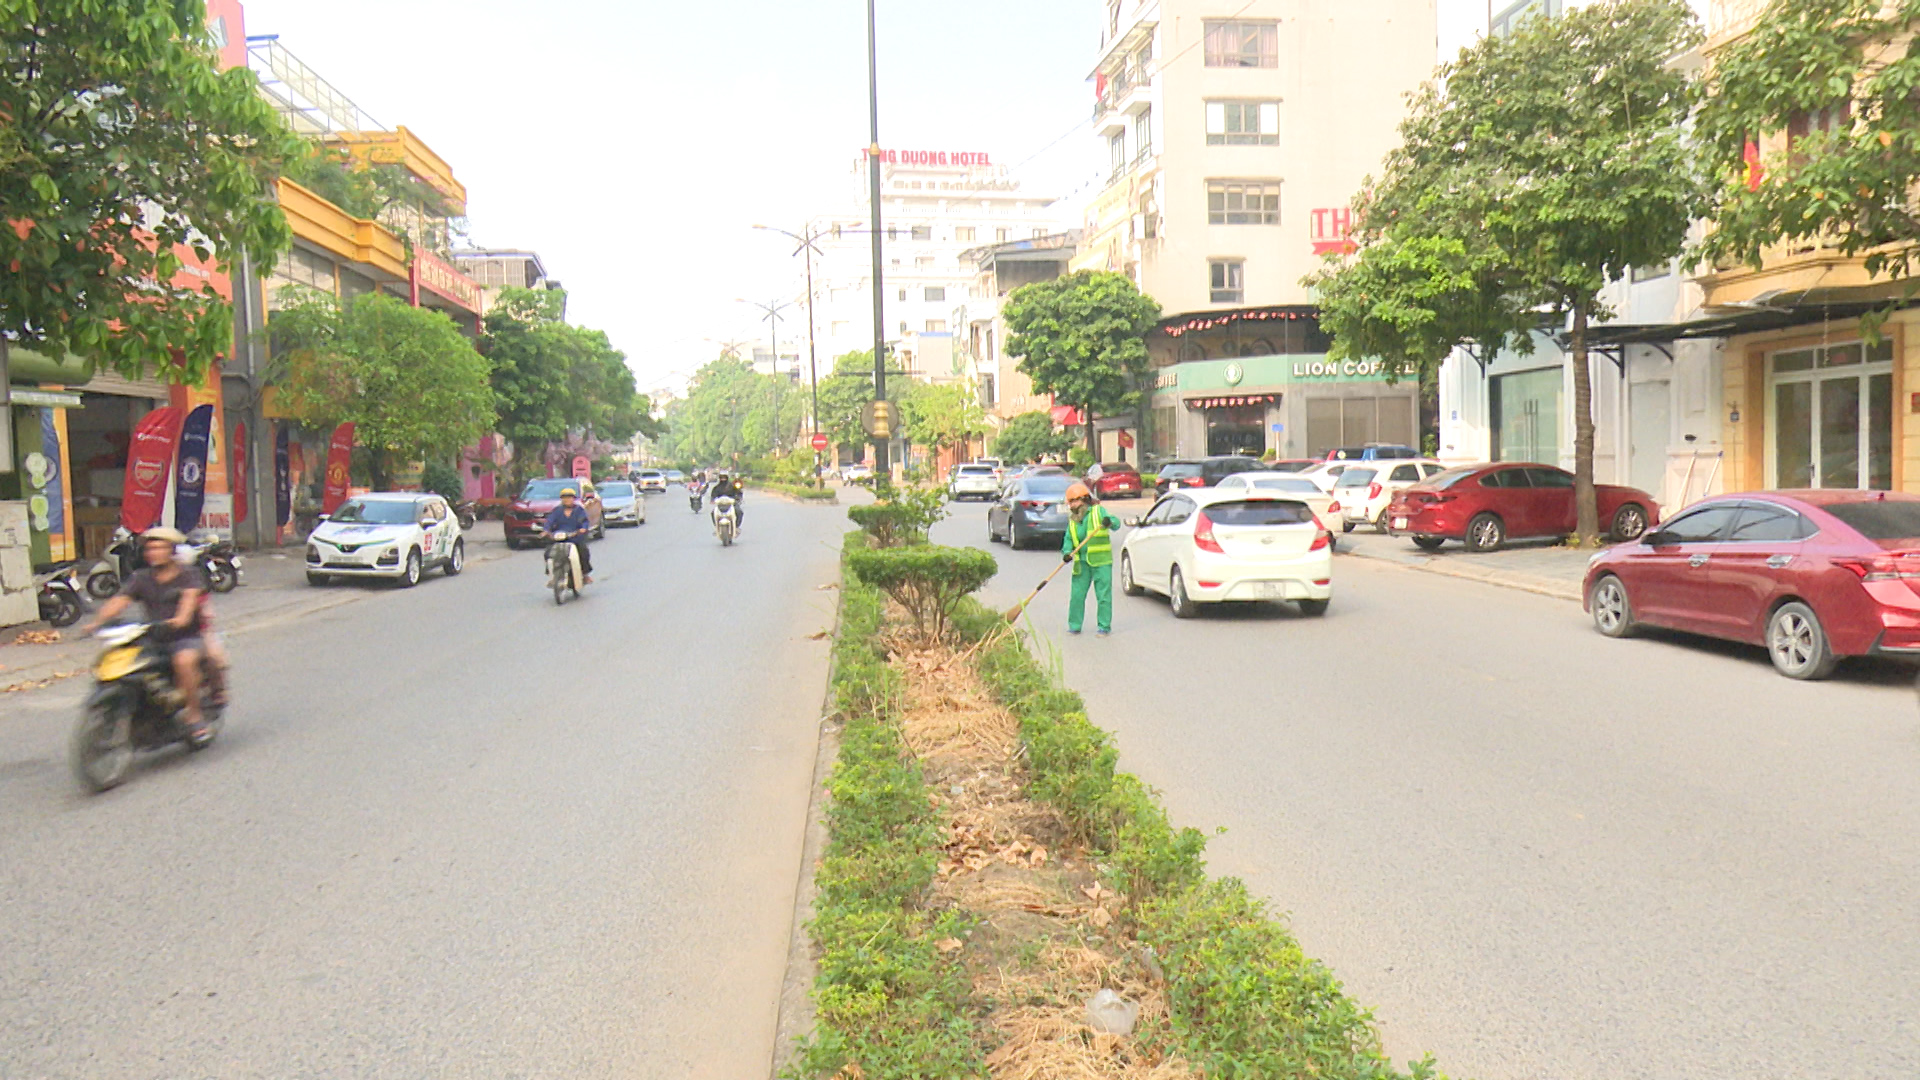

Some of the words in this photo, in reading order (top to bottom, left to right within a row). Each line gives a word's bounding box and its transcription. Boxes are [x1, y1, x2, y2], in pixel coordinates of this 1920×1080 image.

[861, 147, 897, 163] TNG
[901, 149, 947, 165] DUONG
[950, 151, 992, 167] HOTEL
[1293, 362, 1338, 377] LION
[1342, 361, 1416, 377] COFE
